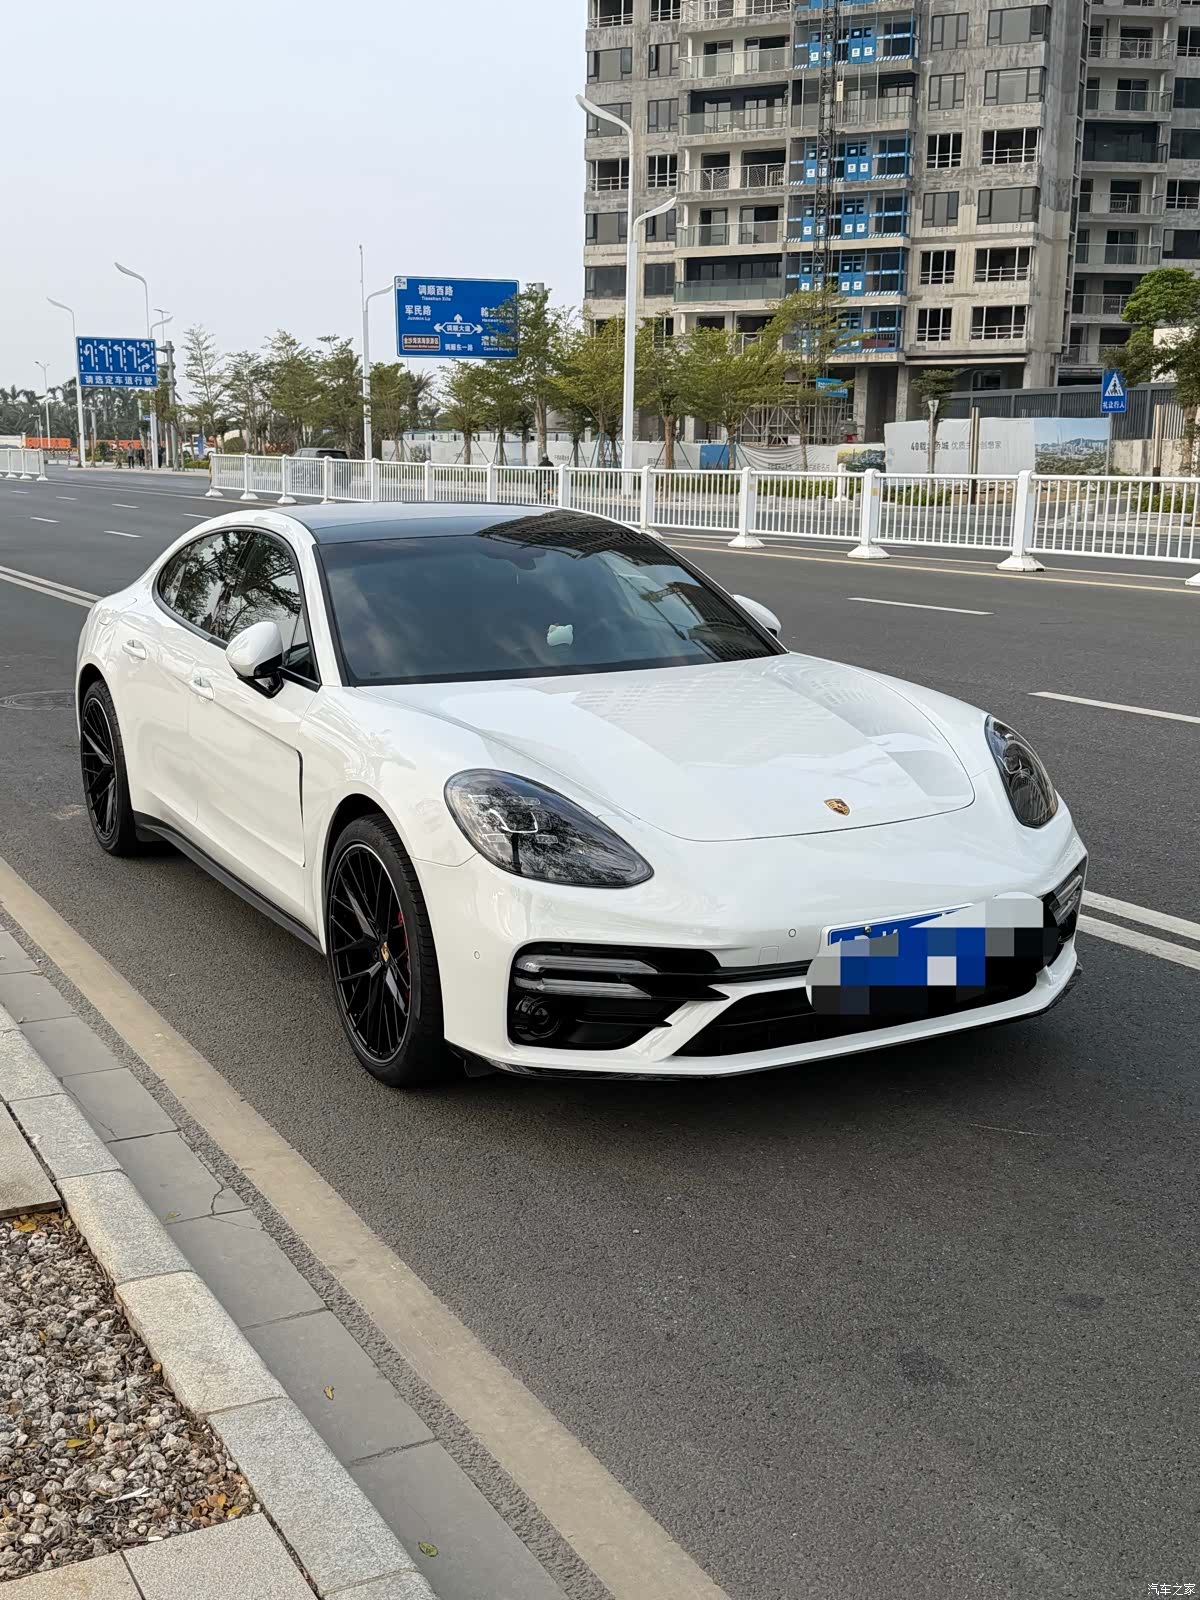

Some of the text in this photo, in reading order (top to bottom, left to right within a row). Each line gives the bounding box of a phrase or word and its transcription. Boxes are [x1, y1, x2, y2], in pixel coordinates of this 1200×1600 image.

[418, 285, 453, 296] 调顺西路
[405, 305, 431, 316] 军民路
[444, 343, 473, 351] 调顺东一路
[85, 375, 153, 385] 请选定车道行驶
[1102, 401, 1125, 409] 礼让行人
